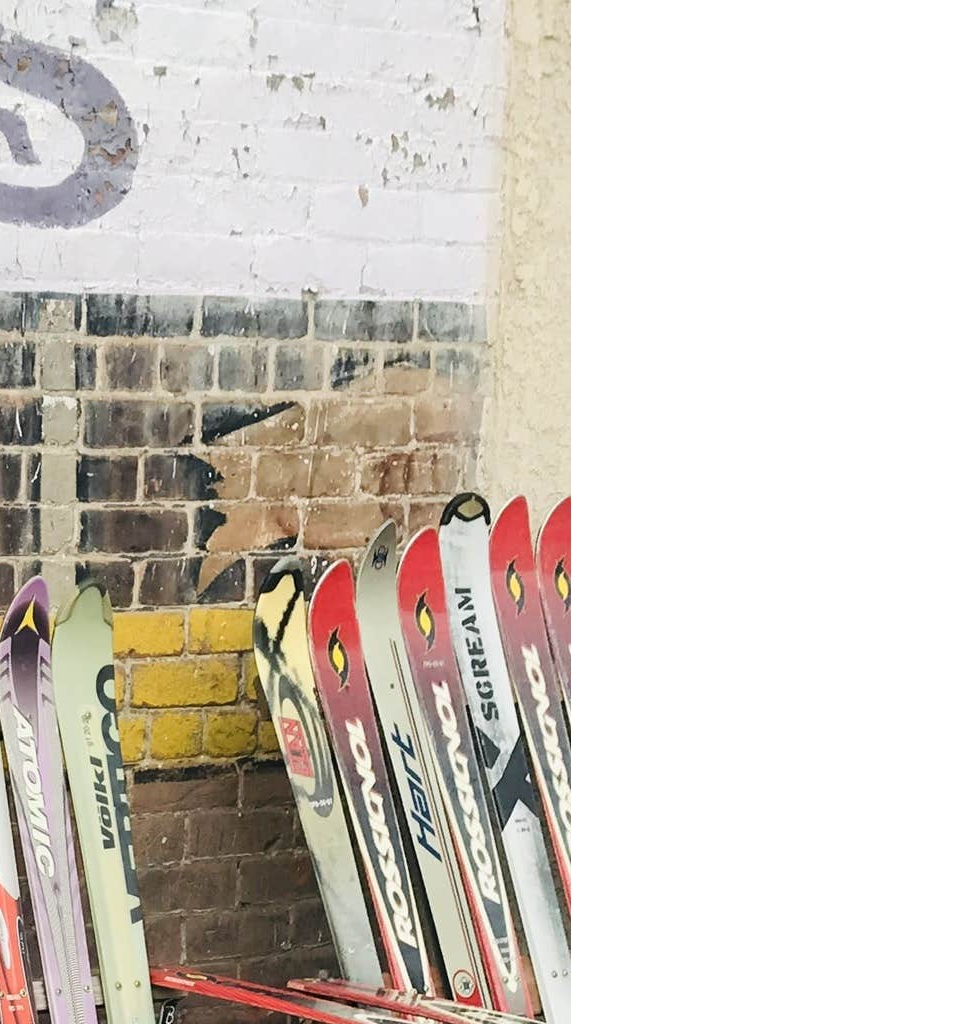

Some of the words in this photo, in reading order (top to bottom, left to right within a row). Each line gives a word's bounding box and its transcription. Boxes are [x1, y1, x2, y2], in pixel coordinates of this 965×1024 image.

[454, 587, 499, 721] SCREAM
[13, 704, 55, 878] ATOMIC
[345, 717, 418, 949] ROSSIGNOL
[430, 681, 501, 904] ROSSIGNOL
